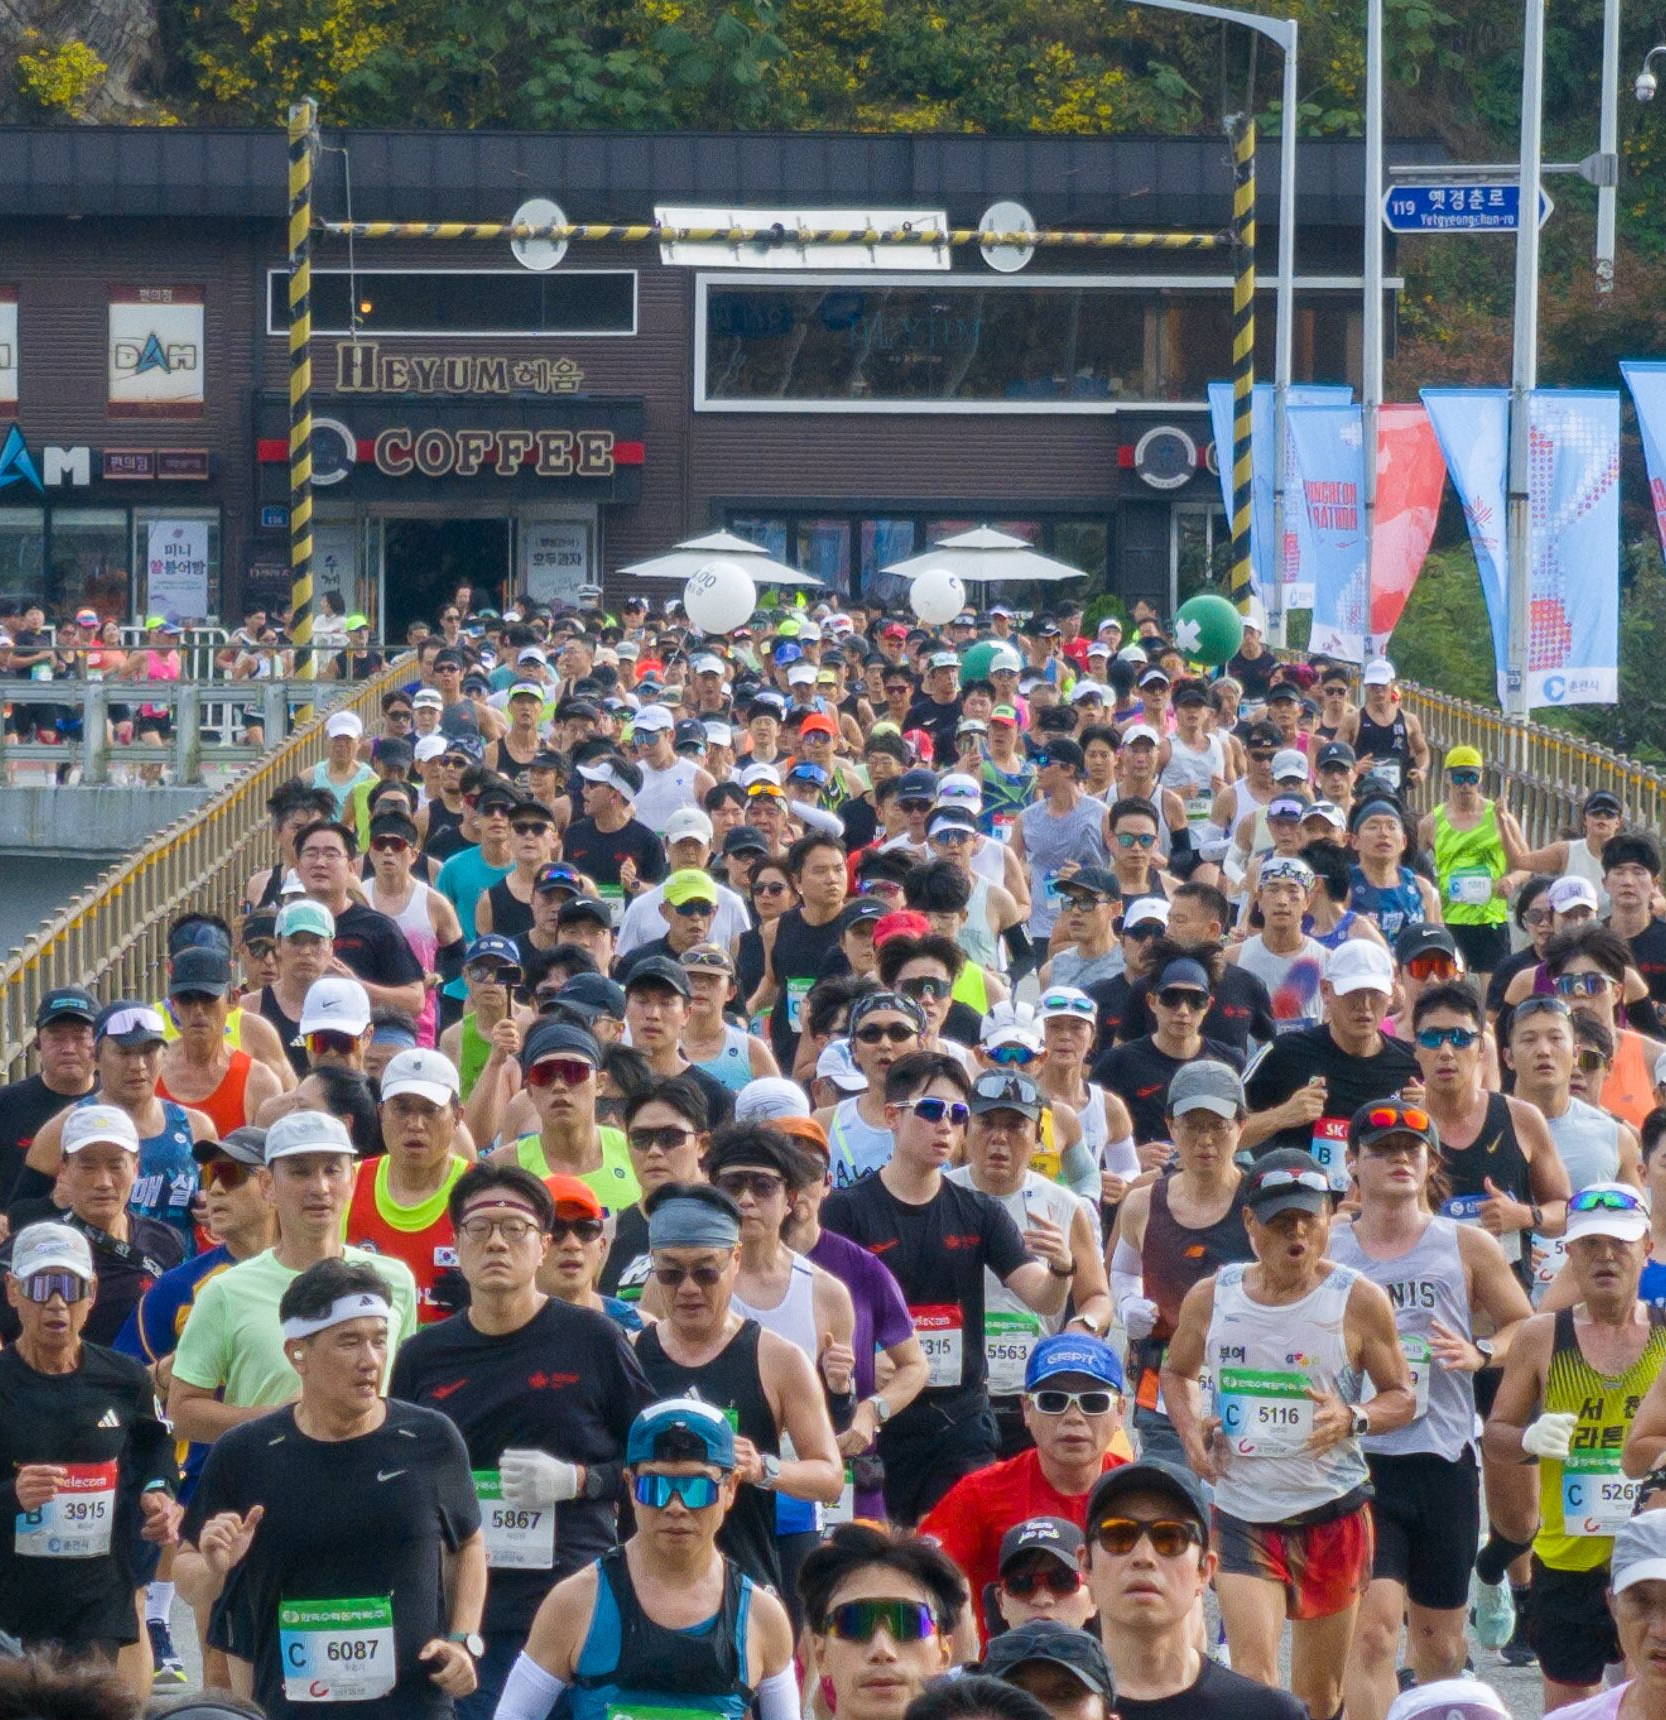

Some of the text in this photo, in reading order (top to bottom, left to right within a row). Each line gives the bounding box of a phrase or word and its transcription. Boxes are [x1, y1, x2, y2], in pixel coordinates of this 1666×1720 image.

[1428, 188, 1506, 211] 옛경춘로
[115, 331, 196, 374] DAM
[336, 341, 510, 393] HEYUM
[374, 428, 616, 476] COFFEE
[1319, 1146, 1331, 1164] B
[986, 1342, 1028, 1361] 5563
[1219, 1345, 1246, 1365] 부여
[1224, 1403, 1239, 1427] C
[1257, 1405, 1300, 1425] 5116
[60, 1474, 108, 1490] elecom
[1568, 1484, 1582, 1506] C
[64, 1501, 106, 1521] 3915
[492, 1510, 542, 1531] 5867
[289, 1643, 307, 1669] C
[327, 1638, 380, 1662] 6087
